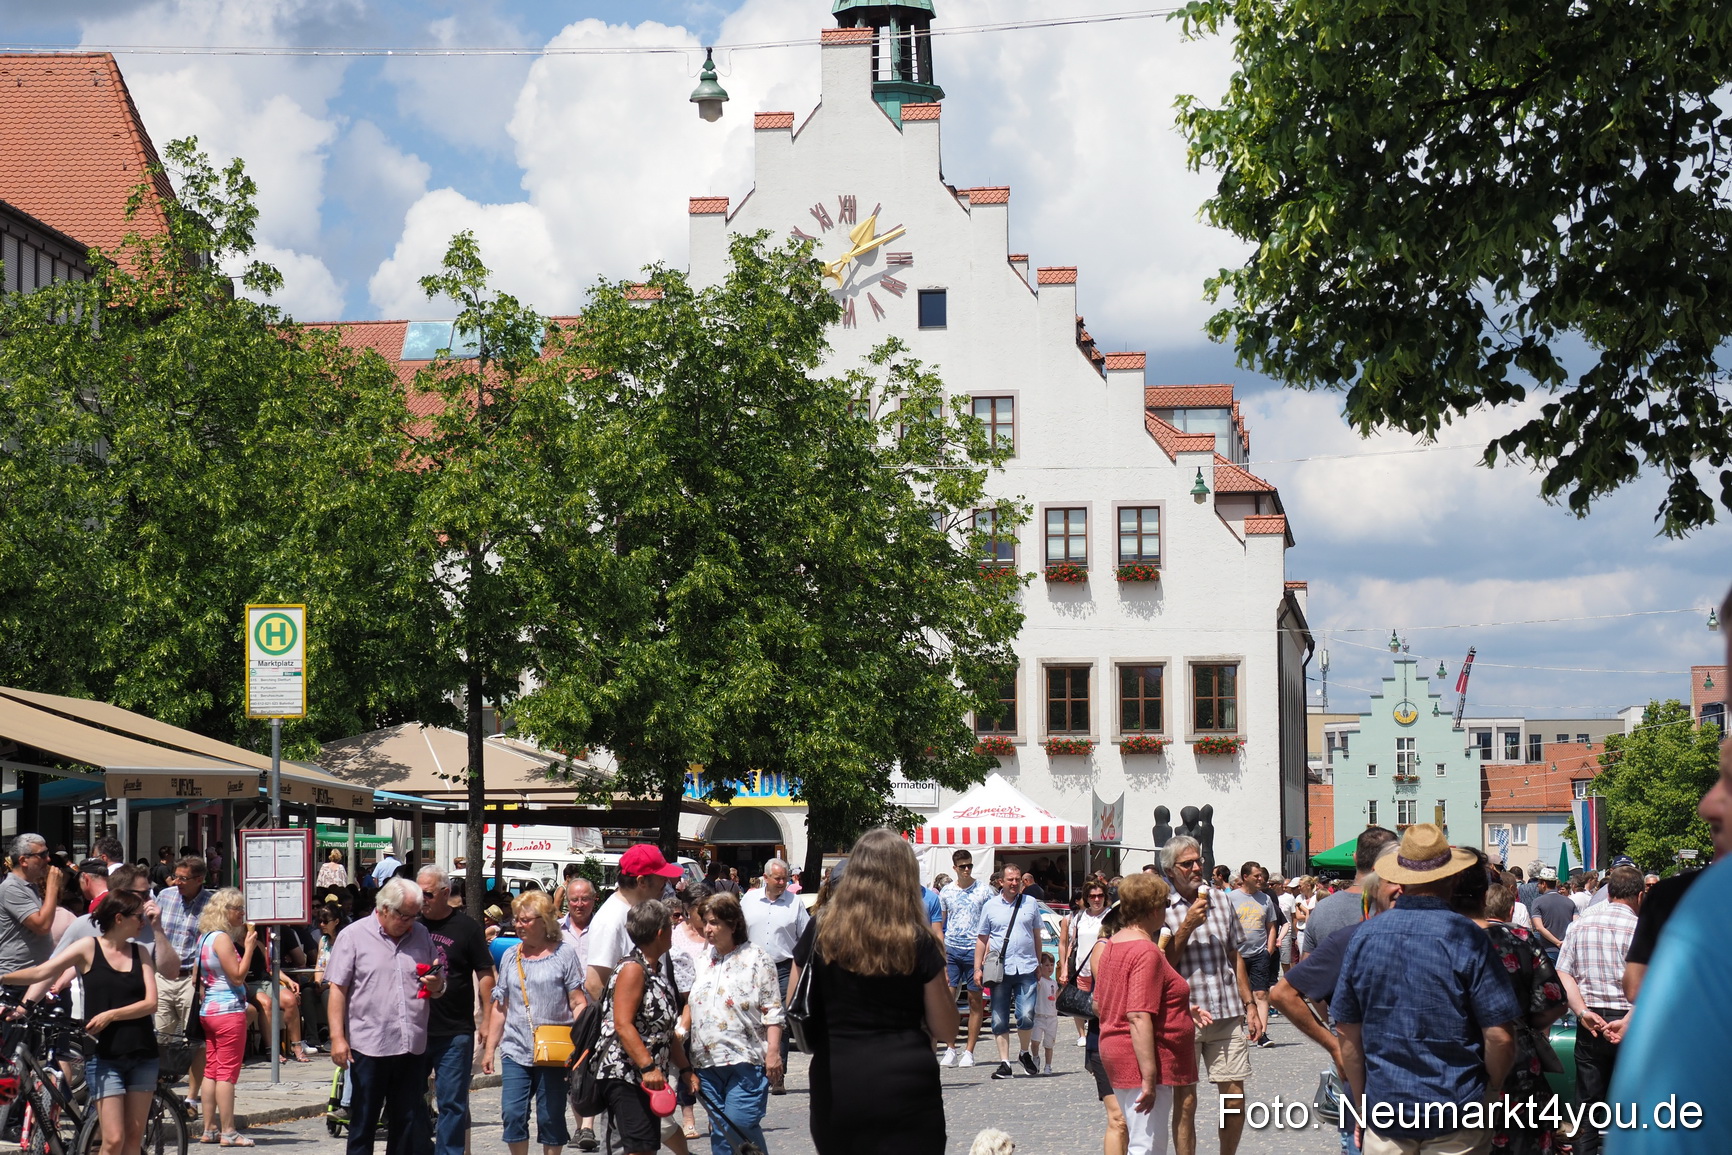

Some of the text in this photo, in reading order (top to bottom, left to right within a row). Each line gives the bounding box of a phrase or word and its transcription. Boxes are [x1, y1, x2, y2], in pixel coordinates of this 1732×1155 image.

[265, 622, 286, 646] H
[953, 805, 1021, 819] Lehmeier's
[430, 933, 455, 947] TTITUDE
